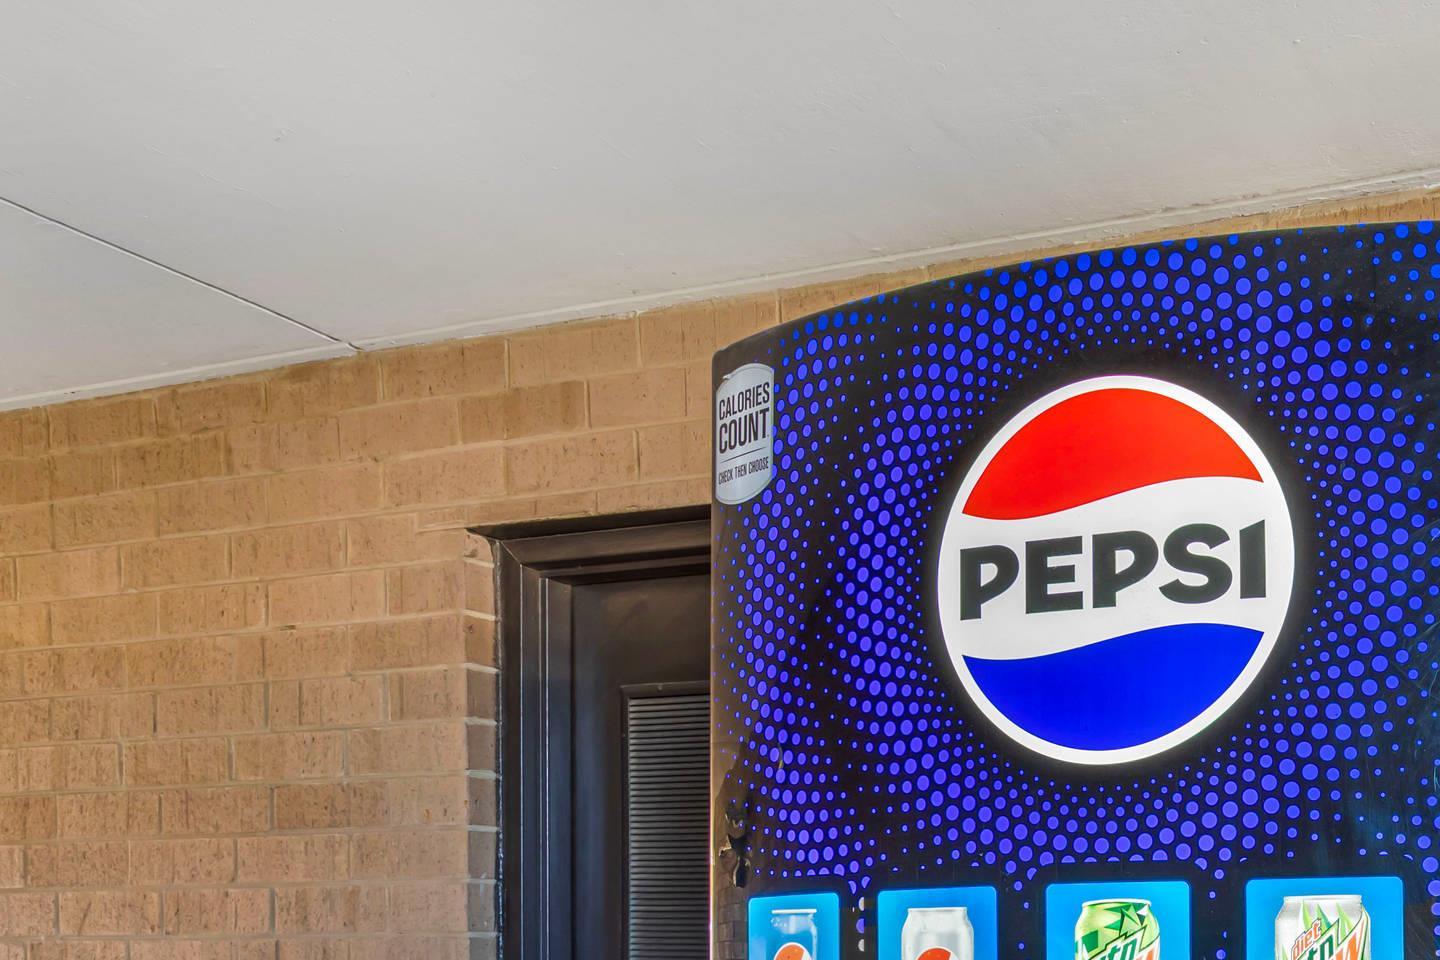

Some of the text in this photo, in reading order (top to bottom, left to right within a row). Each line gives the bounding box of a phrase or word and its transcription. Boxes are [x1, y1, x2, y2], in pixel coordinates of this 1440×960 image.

[720, 382, 770, 420] CALORIES
[719, 456, 769, 485] CHECK THEN CHOOSE
[960, 519, 1266, 621] PEPSI
[1291, 922, 1321, 957] diet
